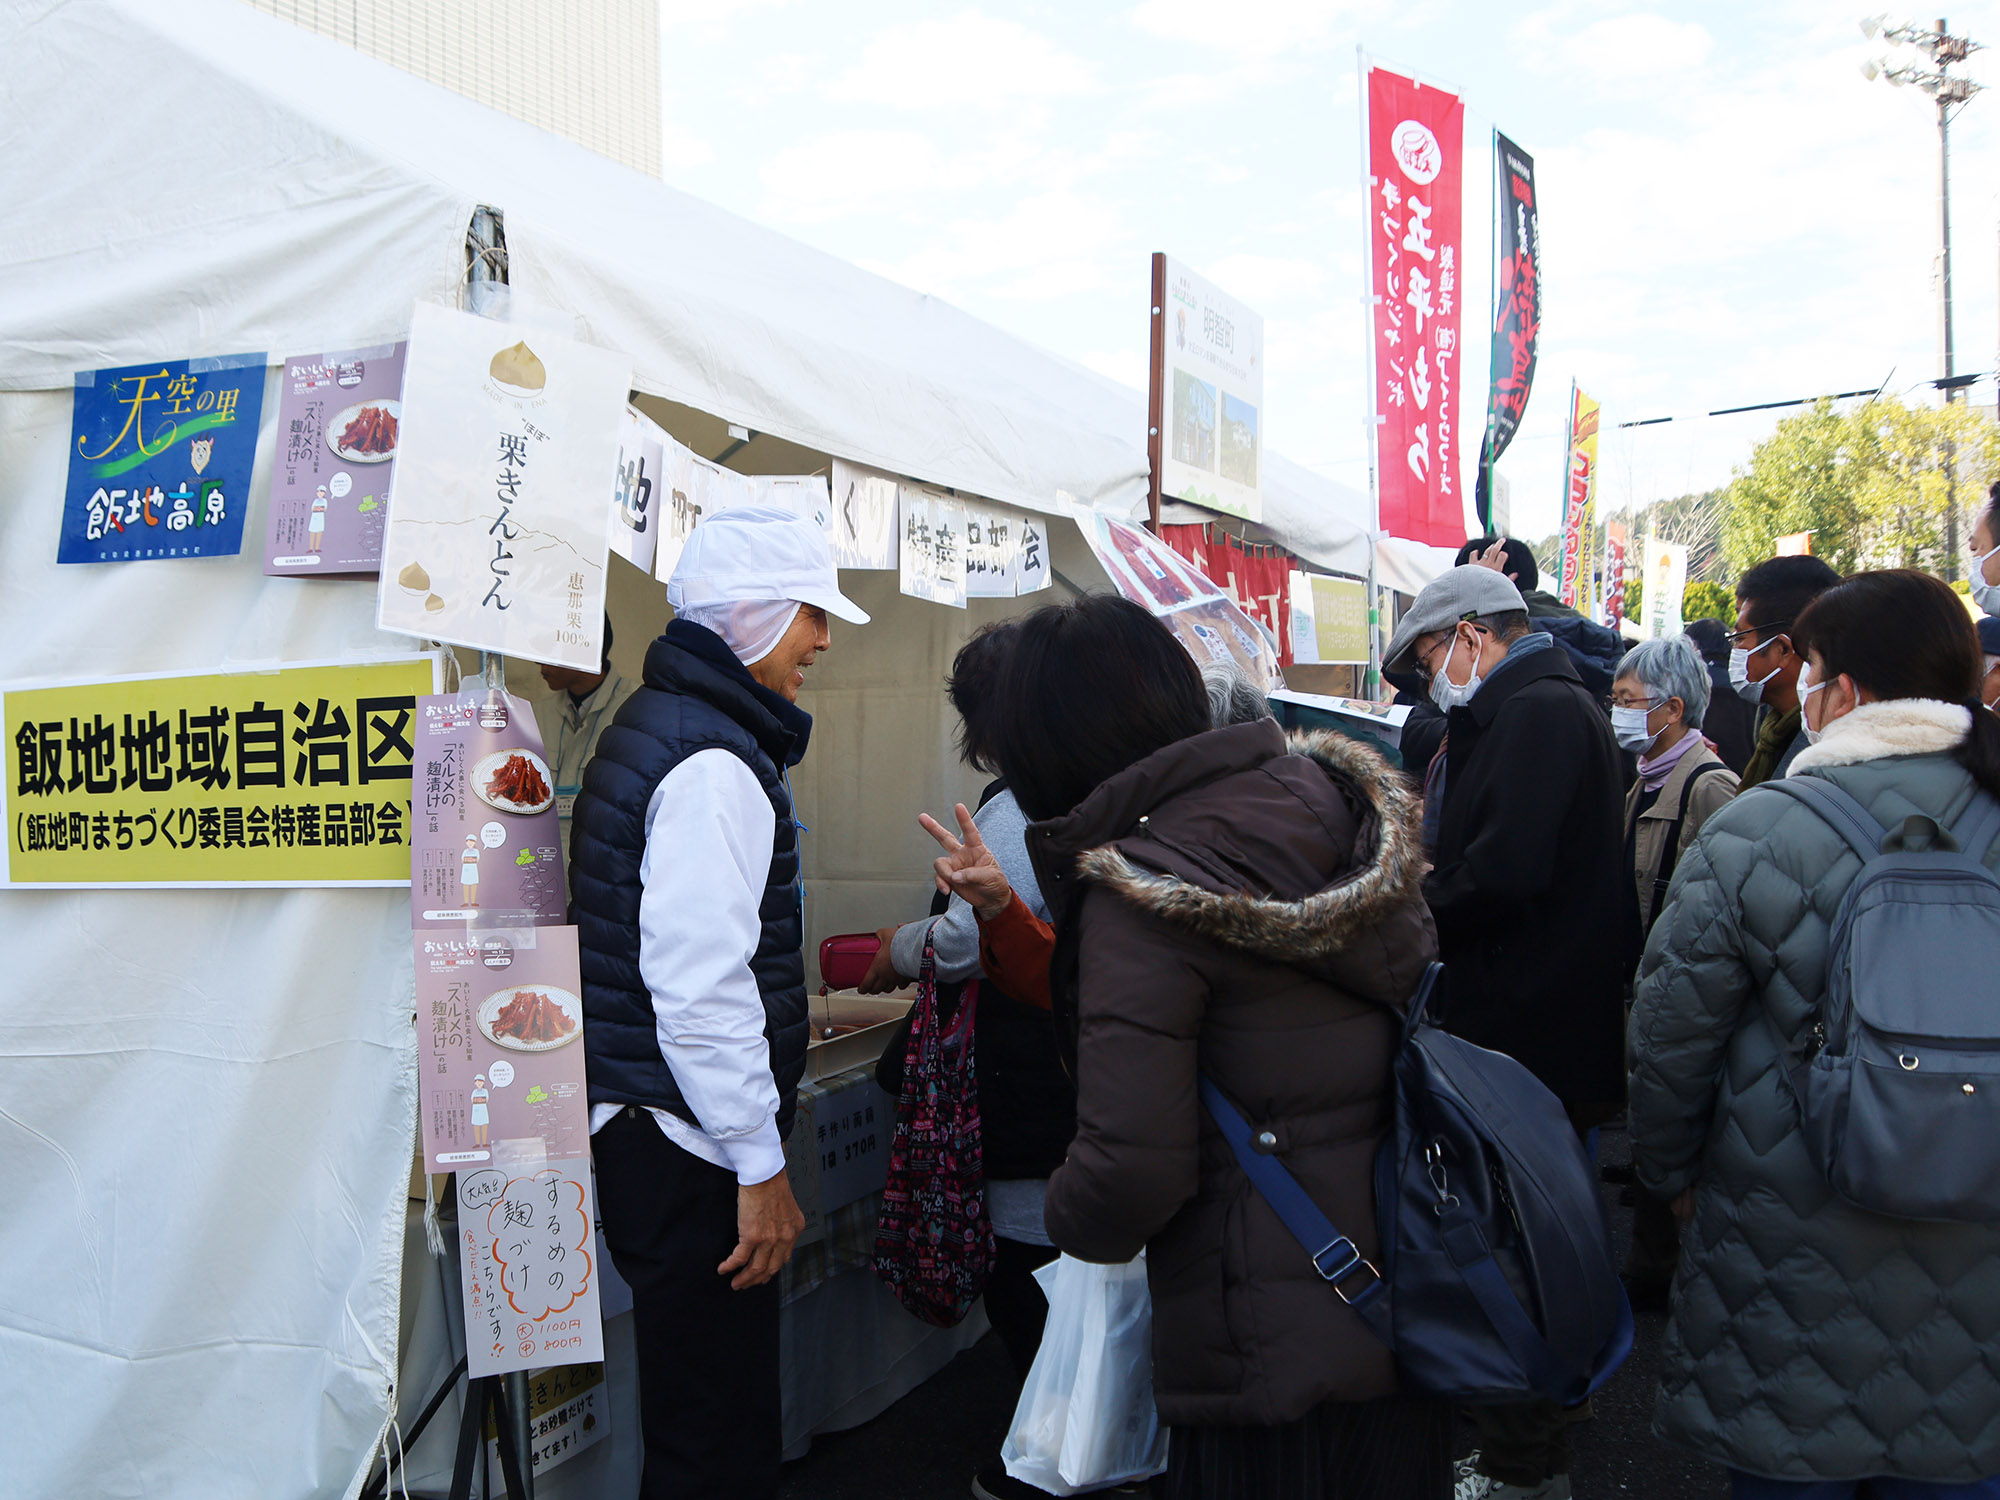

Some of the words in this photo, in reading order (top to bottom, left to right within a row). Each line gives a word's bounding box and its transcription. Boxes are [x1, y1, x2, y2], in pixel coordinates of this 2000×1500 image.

[78, 368, 240, 460] 天空の里
[481, 383, 504, 405] MADE
[513, 401, 523, 409] IN
[531, 398, 548, 409] ENA
[85, 479, 226, 541] 飯地高原
[482, 431, 527, 611] 栗きんとん
[567, 572, 585, 629] 恵那栗
[555, 630, 590, 649] 100%
[15, 695, 416, 798] 飯地地域自治区
[442, 743, 457, 807] 「スルメの
[447, 982, 463, 1047] 「スルメの
[844, 1134, 876, 1161] 370円
[544, 1178, 566, 1291] するめの
[539, 1319, 581, 1335] 1100円
[543, 1336, 582, 1352] 800円
